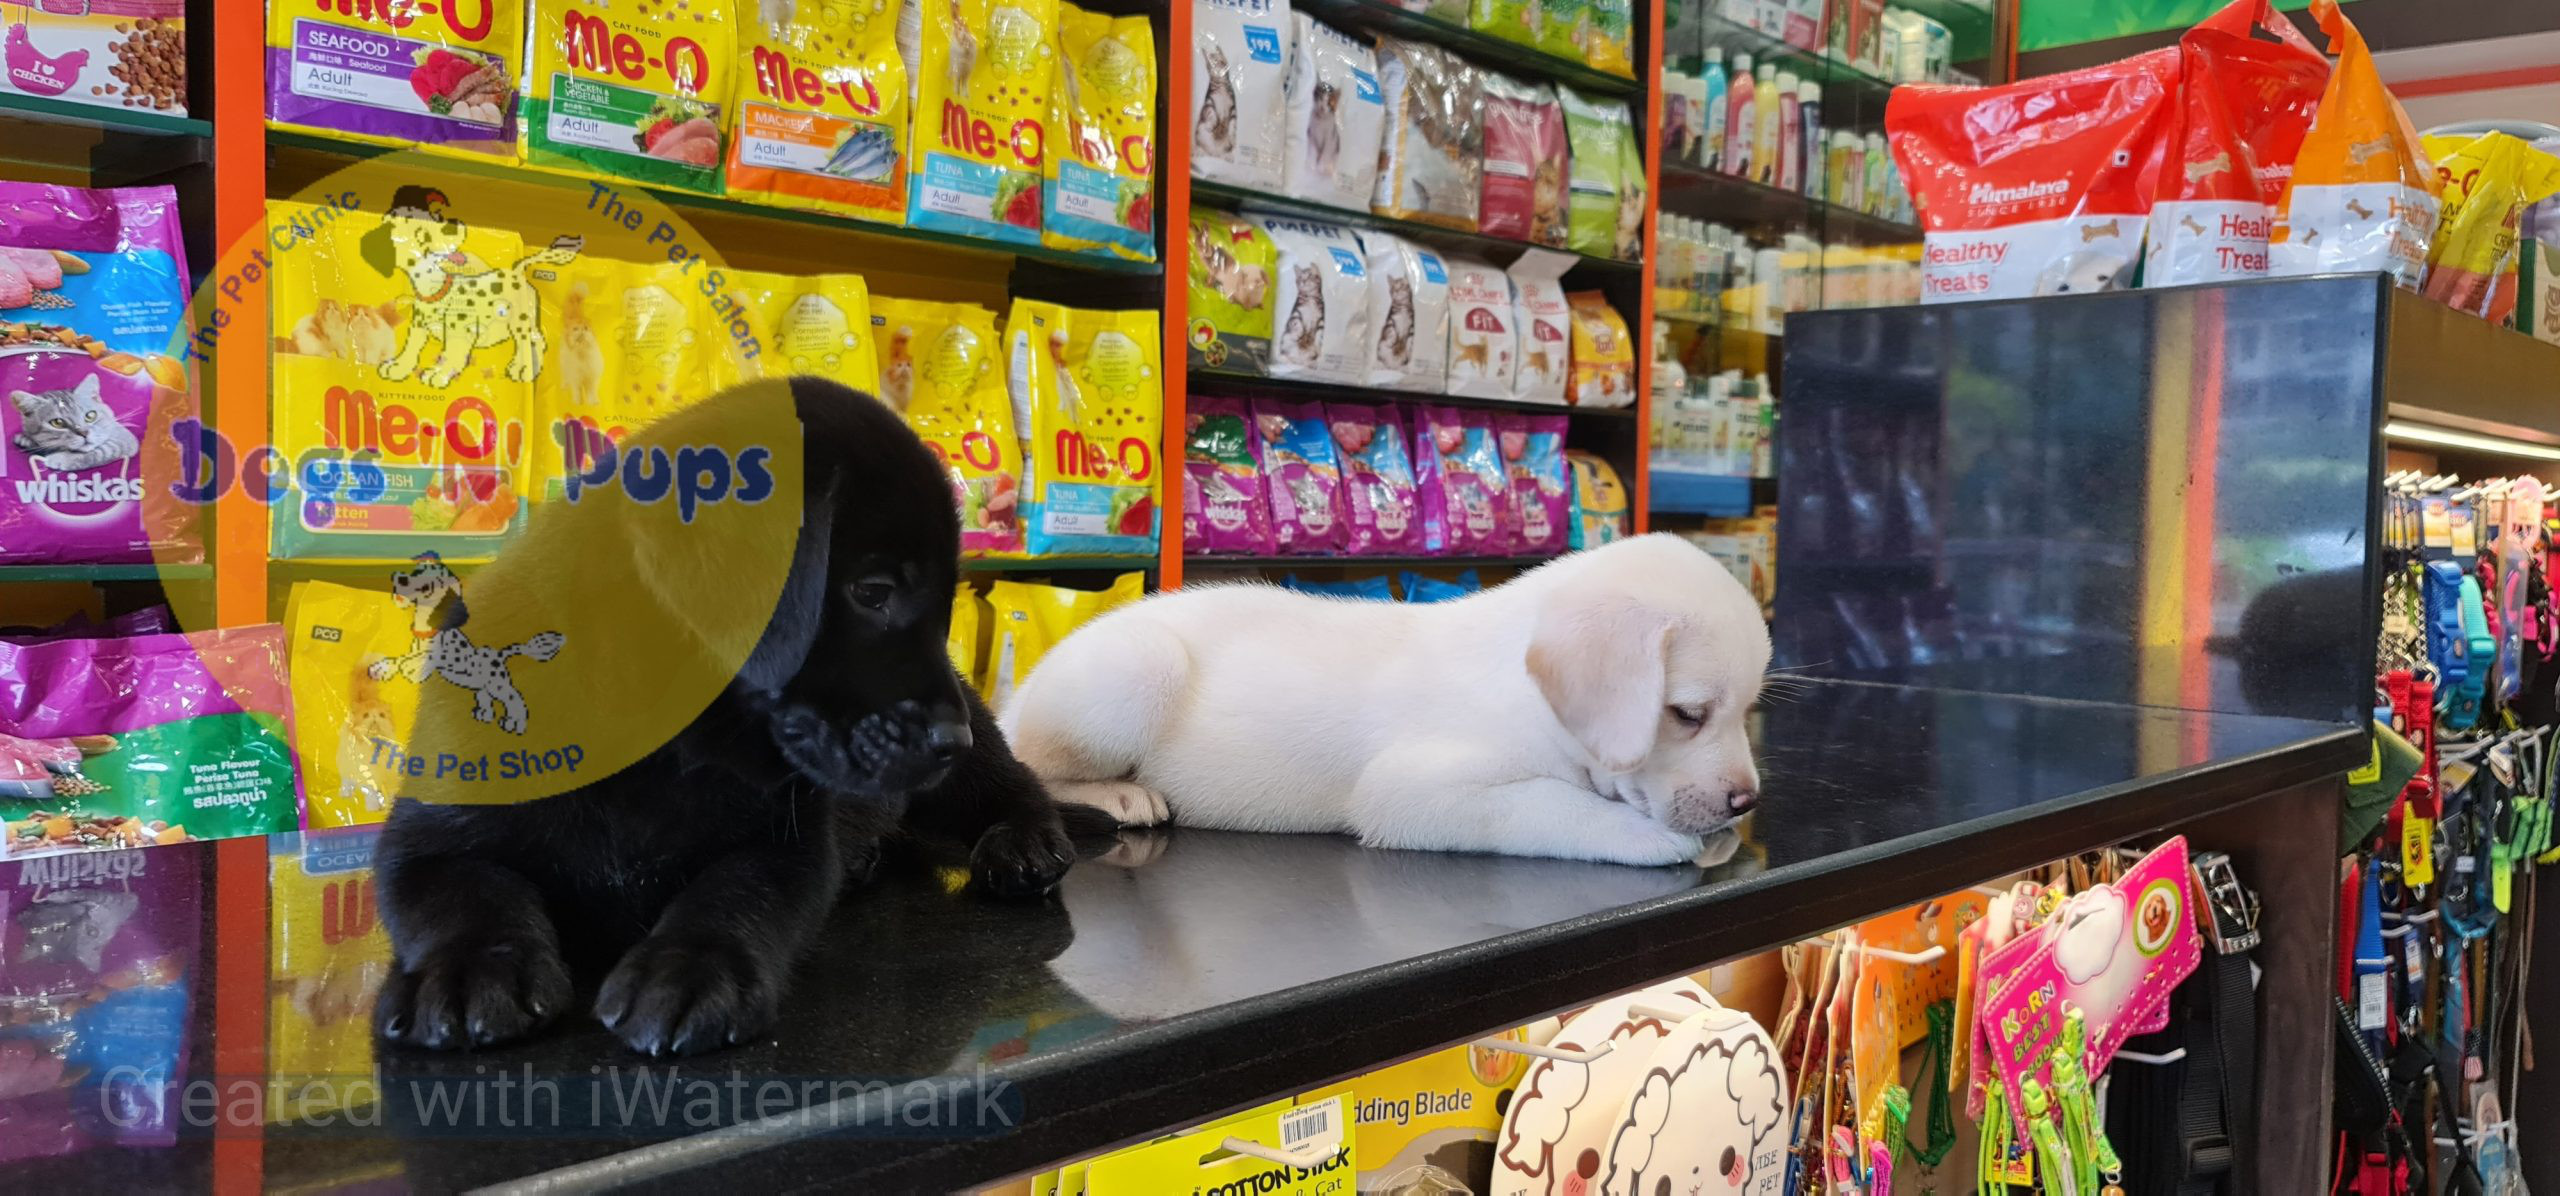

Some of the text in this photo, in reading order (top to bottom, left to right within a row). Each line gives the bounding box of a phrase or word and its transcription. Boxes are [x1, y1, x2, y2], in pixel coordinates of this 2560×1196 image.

[613, 20, 662, 39] CAT FOOD
[308, 30, 389, 57] SEAFOOD
[349, 59, 387, 73] Seafood
[13, 68, 65, 89] CHICKEN
[308, 67, 352, 86] Adult
[564, 80, 603, 96] CHICKEN
[564, 88, 610, 105] VEGETABLE
[562, 118, 599, 134] Adult
[754, 142, 786, 157] Adult
[935, 160, 964, 178] TUNA
[1066, 166, 1091, 185] TUNA
[932, 189, 961, 204] Adult
[1065, 194, 1089, 208] Adult
[1969, 180, 2070, 205] Himalaya
[1967, 205, 2019, 218] SINCE
[2219, 215, 2273, 238] Healt
[2215, 248, 2270, 271] Treat
[1472, 315, 1495, 330] FIT
[1536, 326, 1551, 339] IT
[378, 391, 446, 402] KITTEN FOOD
[15, 472, 145, 504] whiskas
[319, 471, 414, 488] OCEAN FISH
[1054, 488, 1079, 501] TUNA
[317, 502, 369, 519] Kitten
[1054, 514, 1079, 526] Adult
[313, 626, 340, 641] PCG
[189, 760, 261, 774] Tuna Flavour
[194, 770, 260, 784] Perisa Tuna
[2013, 1012, 2050, 1064] BEST
[1415, 1087, 1472, 1116] Blade
[1315, 1177, 1343, 1196] Cat
[1759, 1171, 1781, 1193] PET
